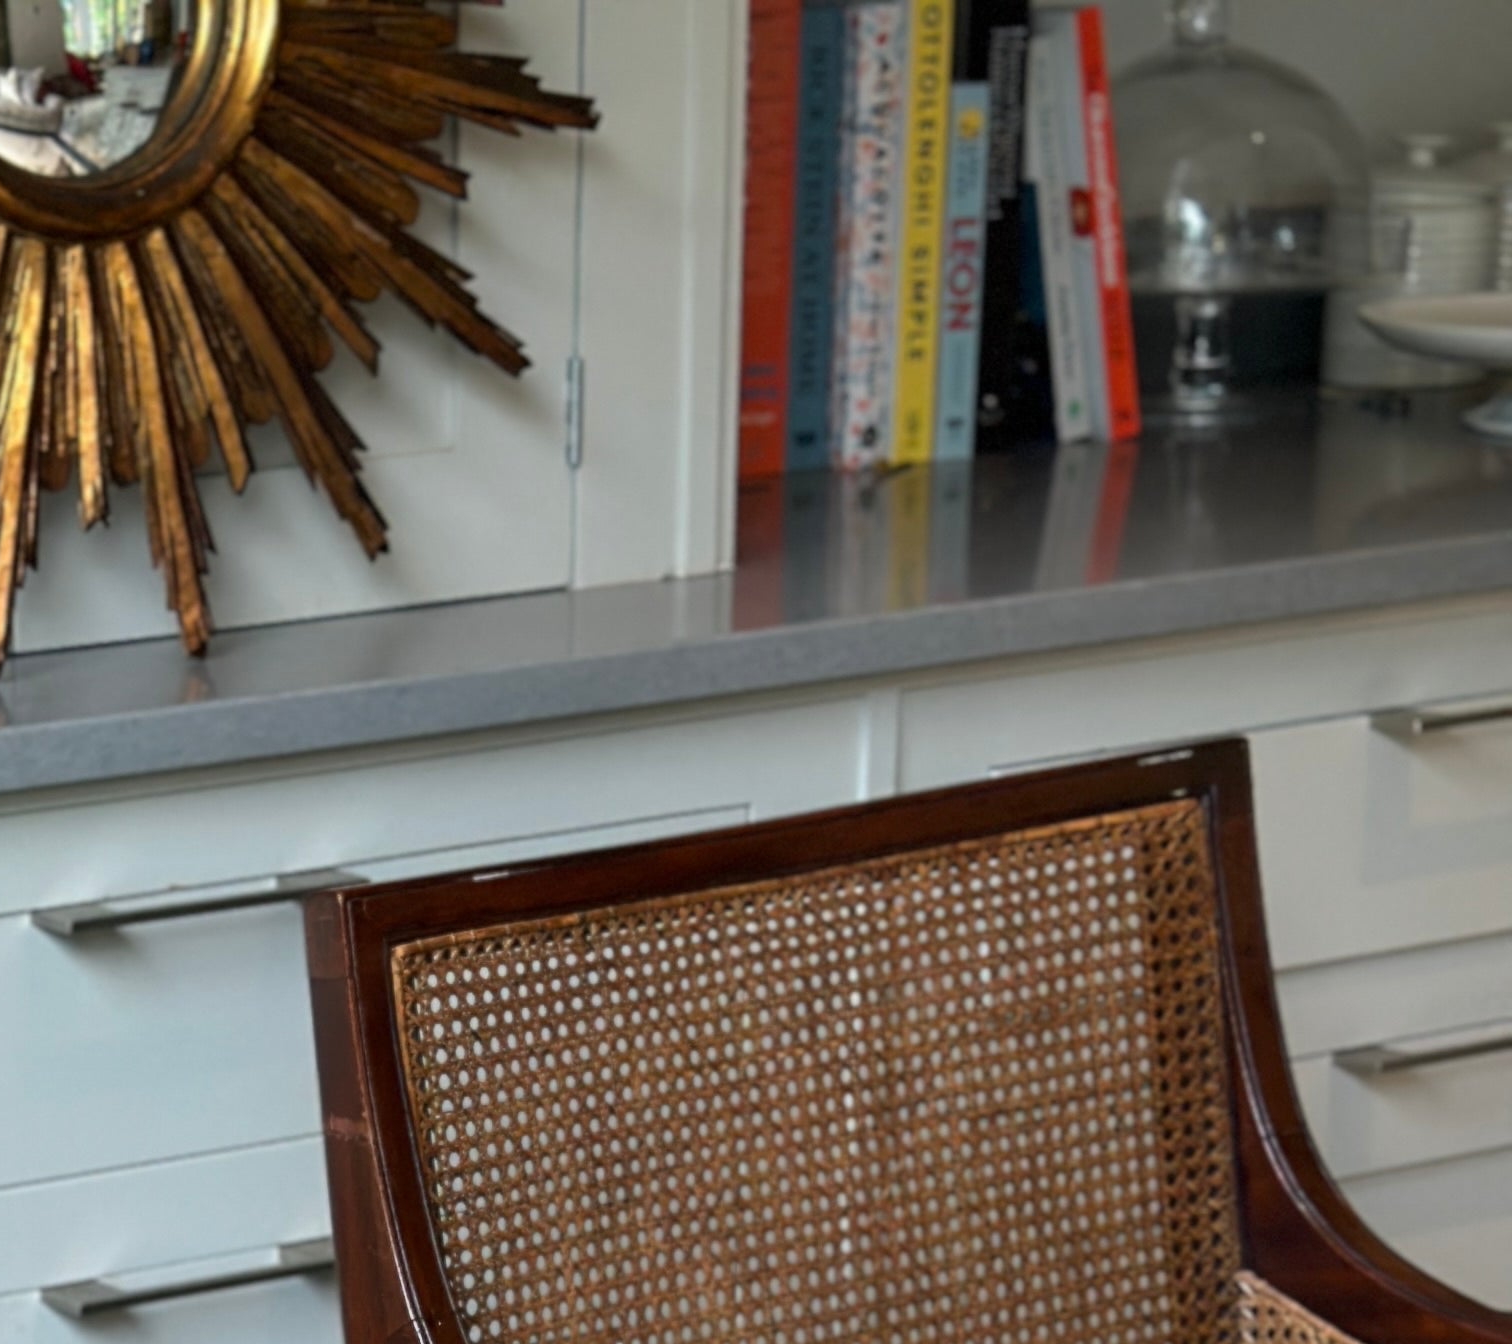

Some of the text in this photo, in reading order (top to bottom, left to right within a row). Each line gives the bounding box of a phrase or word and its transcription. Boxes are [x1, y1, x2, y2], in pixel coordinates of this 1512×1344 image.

[904, 4, 942, 361] OTTOLENGHI SIMPLE
[947, 218, 977, 331] LEON
